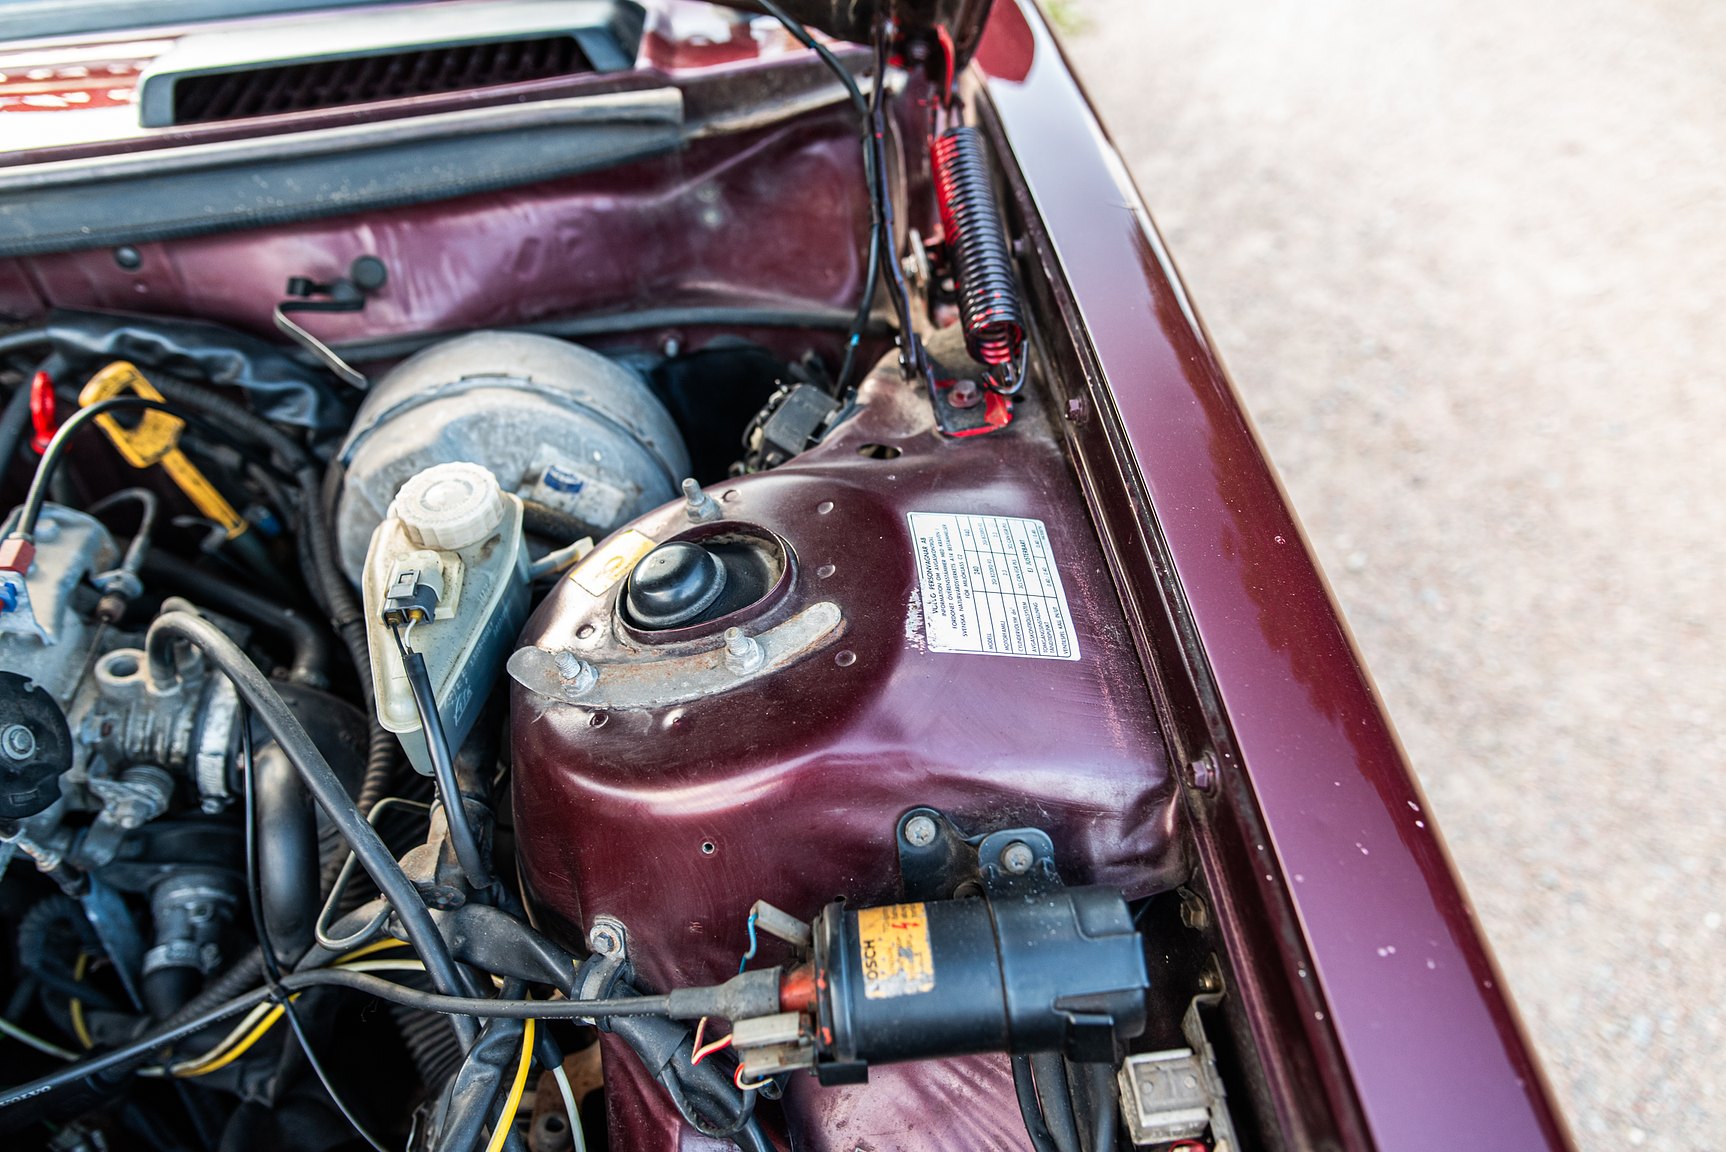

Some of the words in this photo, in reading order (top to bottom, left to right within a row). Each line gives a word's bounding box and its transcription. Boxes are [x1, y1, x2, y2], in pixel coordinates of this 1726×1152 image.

[928, 536, 939, 570] AVGASKONTROLL
[1018, 539, 1031, 565] JUSTERBART
[921, 545, 935, 589] PERSONVAGNAR
[934, 572, 941, 580] OM
[957, 561, 968, 587] MILJÖKLASS
[972, 565, 980, 575] 240
[936, 582, 947, 616] INFORMATION
[948, 562, 964, 611] NATURVÅRDSVERKETS
[947, 602, 958, 629] FORDONET
[958, 613, 968, 636] SVENSKA
[1020, 601, 1038, 652] AVGASKONTROLLSYSTEM
[985, 632, 994, 649] MODELL
[998, 620, 1011, 650] MOTORFAMILJ
